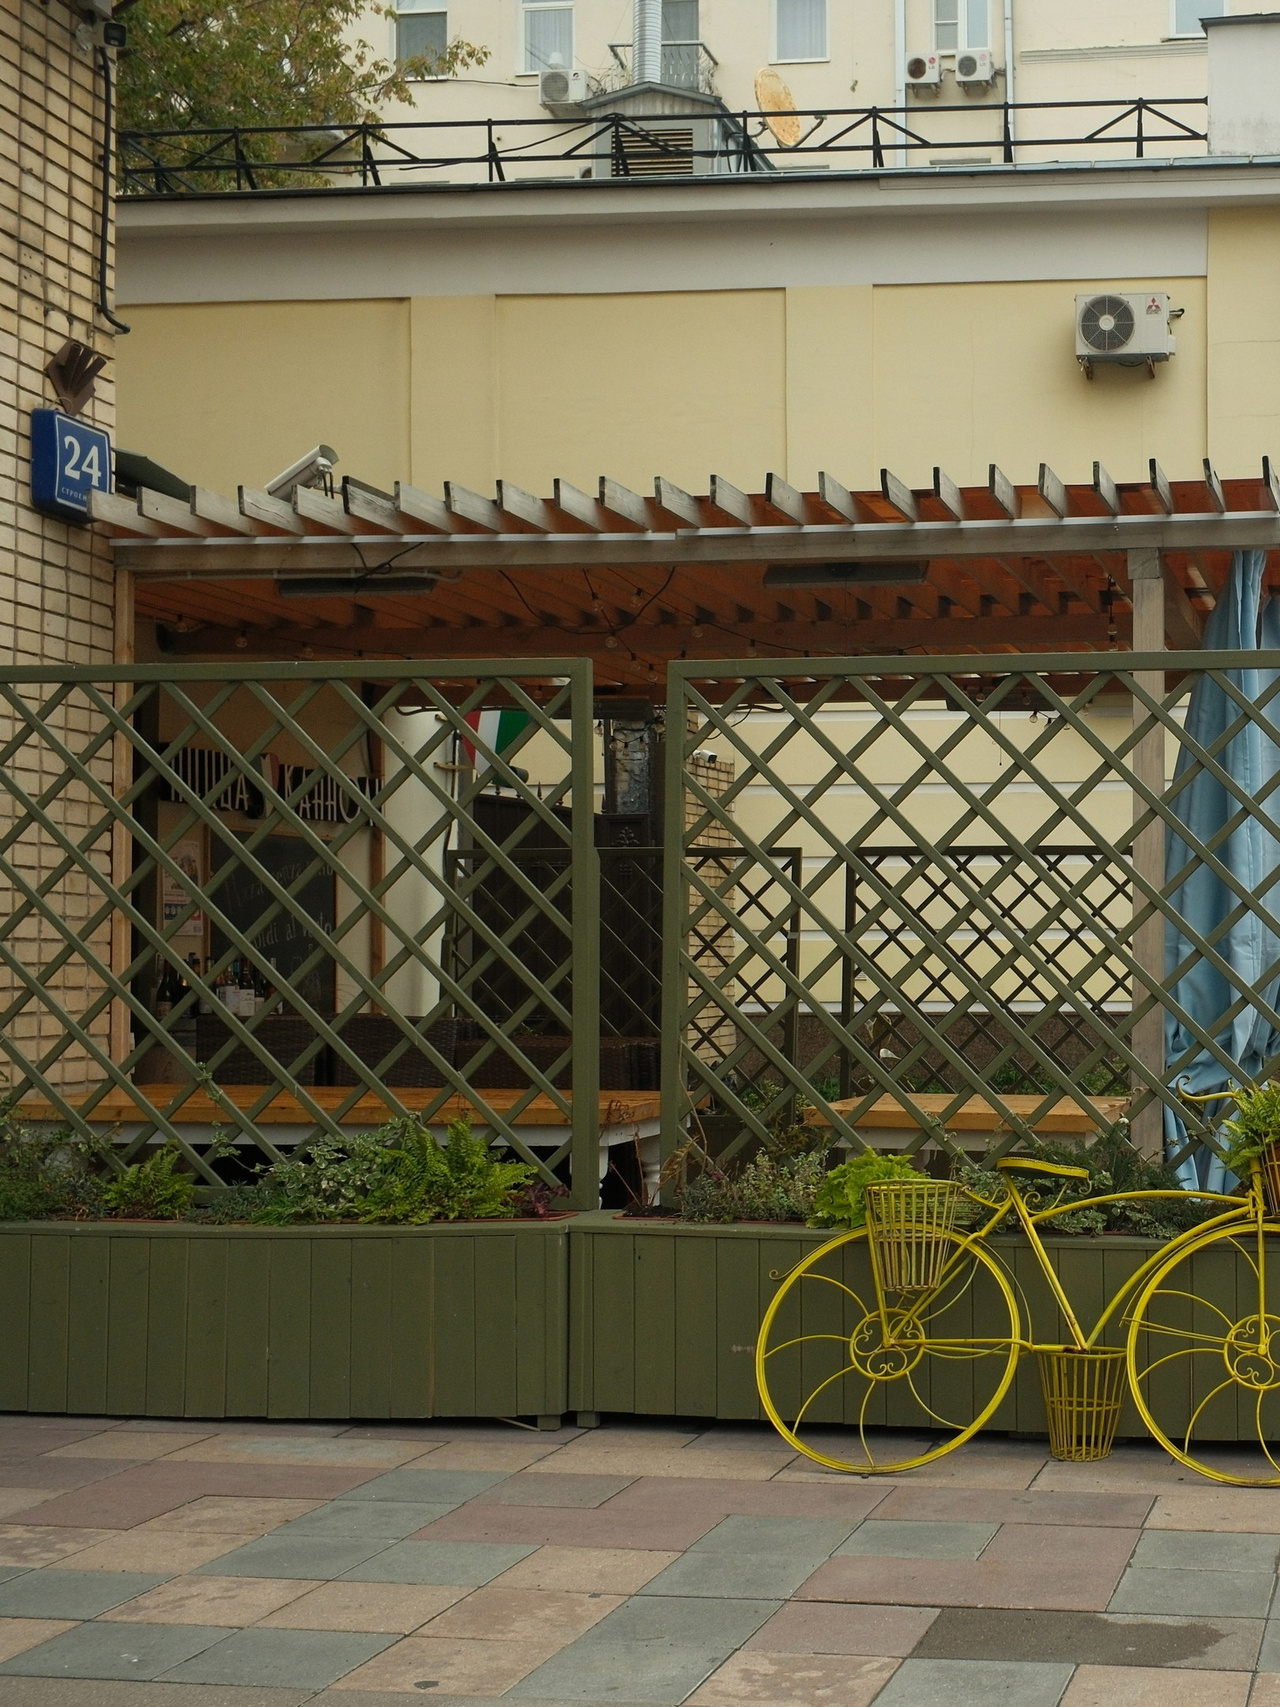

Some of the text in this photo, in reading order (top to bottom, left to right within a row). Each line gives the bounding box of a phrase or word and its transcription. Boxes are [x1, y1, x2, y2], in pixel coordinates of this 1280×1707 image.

[66, 439, 100, 485] 24
[62, 487, 87, 502] СТРОЕН
[286, 915, 297, 942] al
